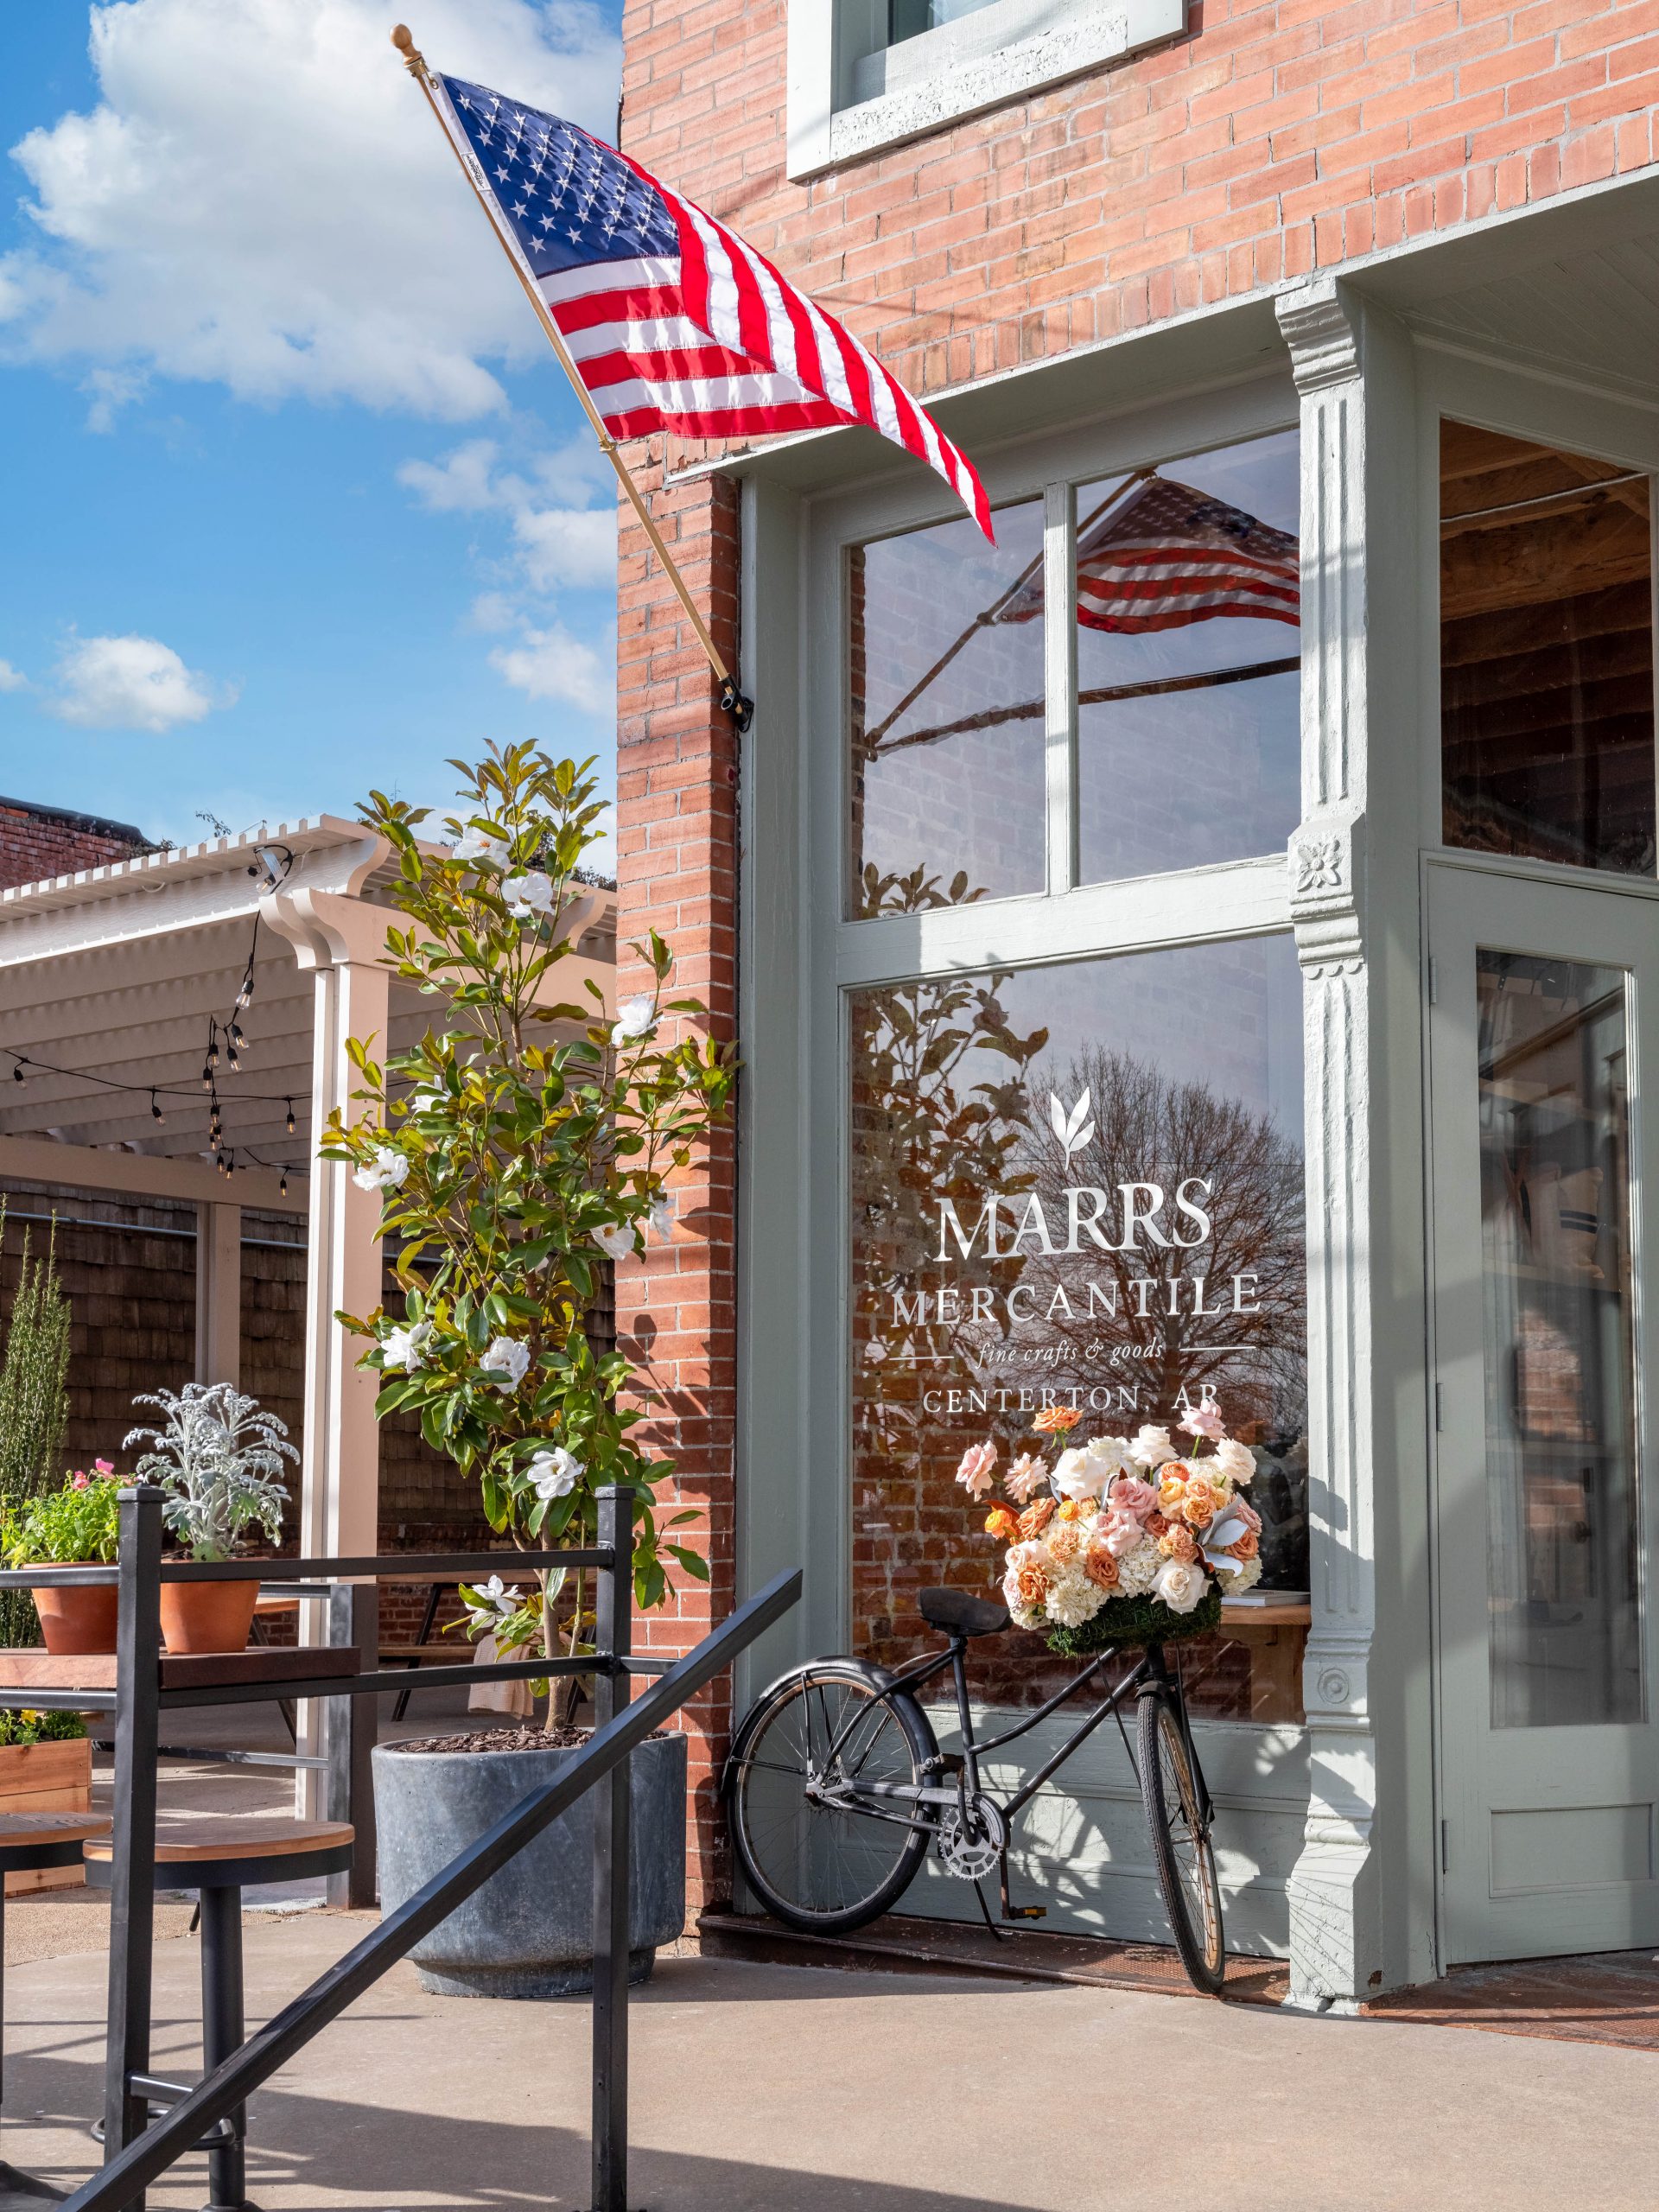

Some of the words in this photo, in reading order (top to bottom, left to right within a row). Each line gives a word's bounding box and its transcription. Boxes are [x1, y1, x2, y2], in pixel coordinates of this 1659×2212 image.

[932, 1177, 1212, 1262] MARRS
[890, 1274, 1262, 1328] MERCANTILE
[975, 1342, 1015, 1370] fine
[1024, 1339, 1077, 1368] crafts
[1085, 1337, 1105, 1360] &
[1109, 1336, 1164, 1367] goods
[922, 1385, 1151, 1414] CENTERTON,
[1171, 1383, 1218, 1411] AR
